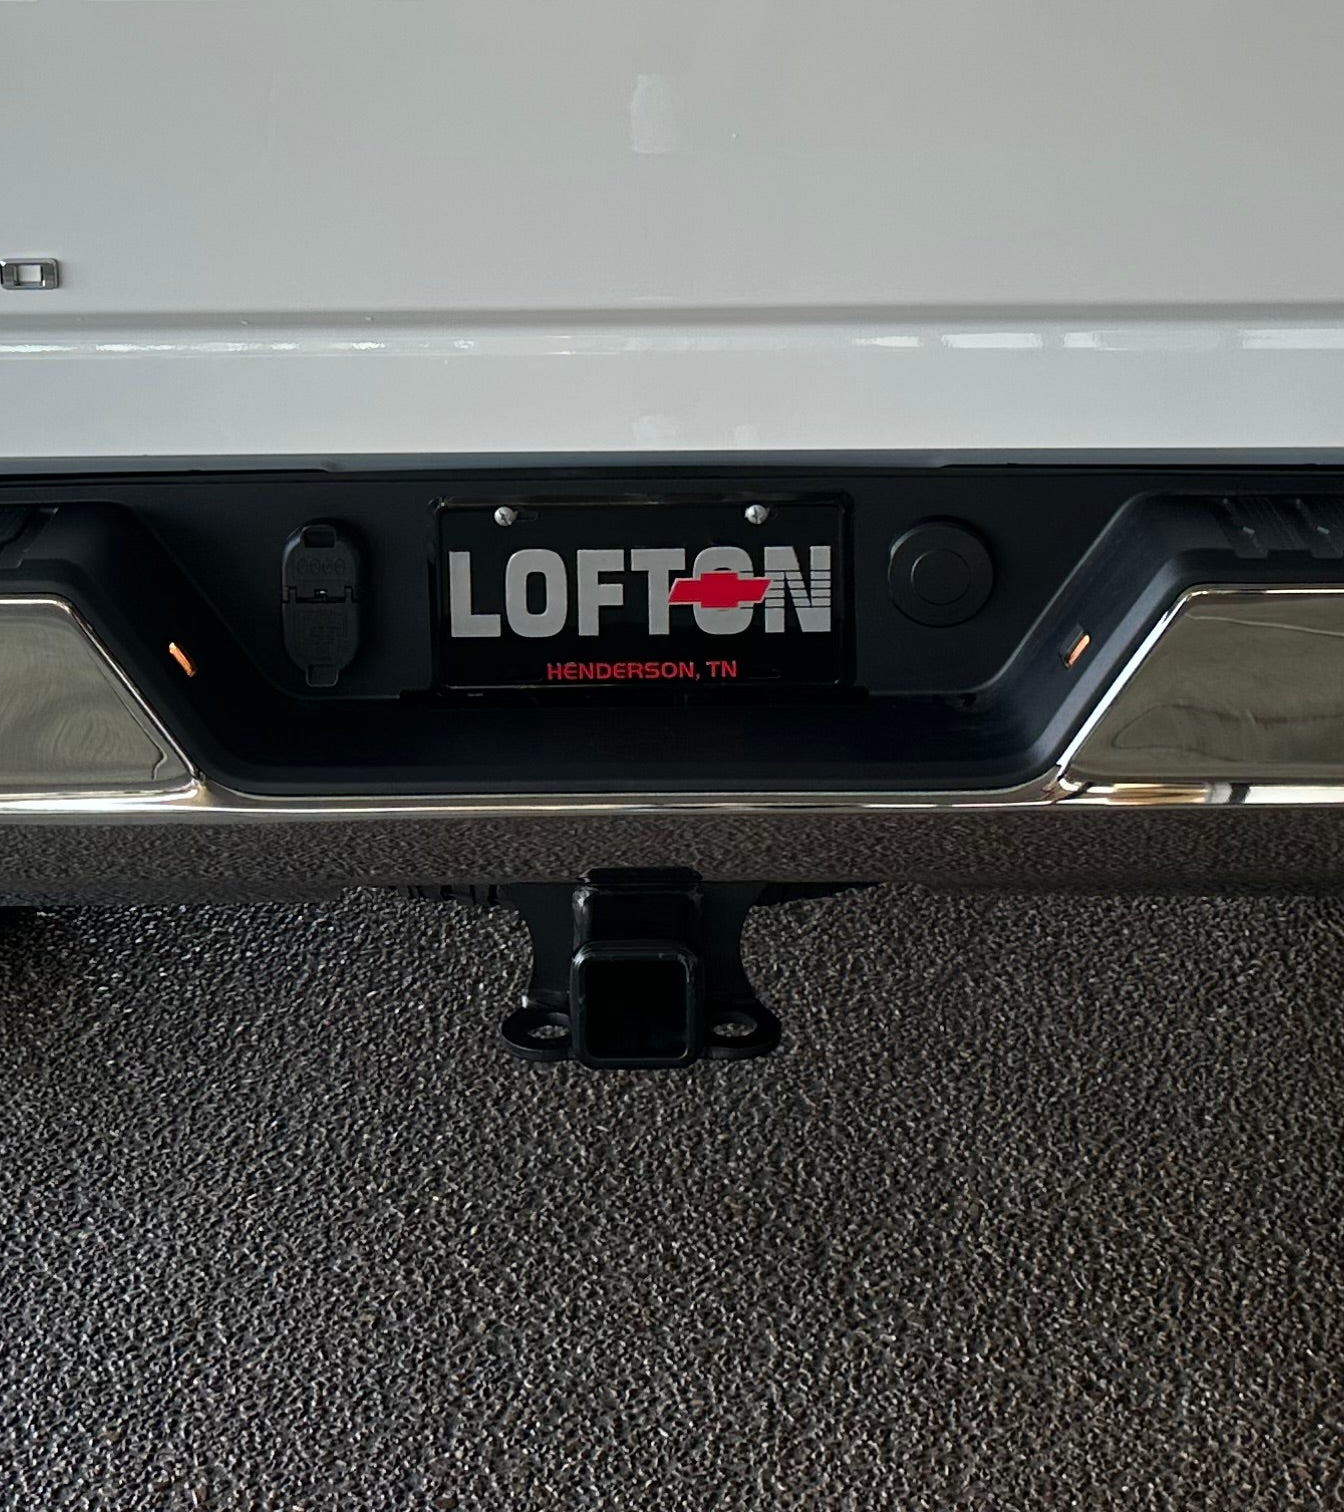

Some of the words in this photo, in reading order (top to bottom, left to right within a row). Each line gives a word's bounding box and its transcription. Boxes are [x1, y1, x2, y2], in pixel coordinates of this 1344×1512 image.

[449, 546, 831, 638] LOFTON
[546, 661, 700, 681] HENDERSON,
[705, 660, 737, 678] TN
